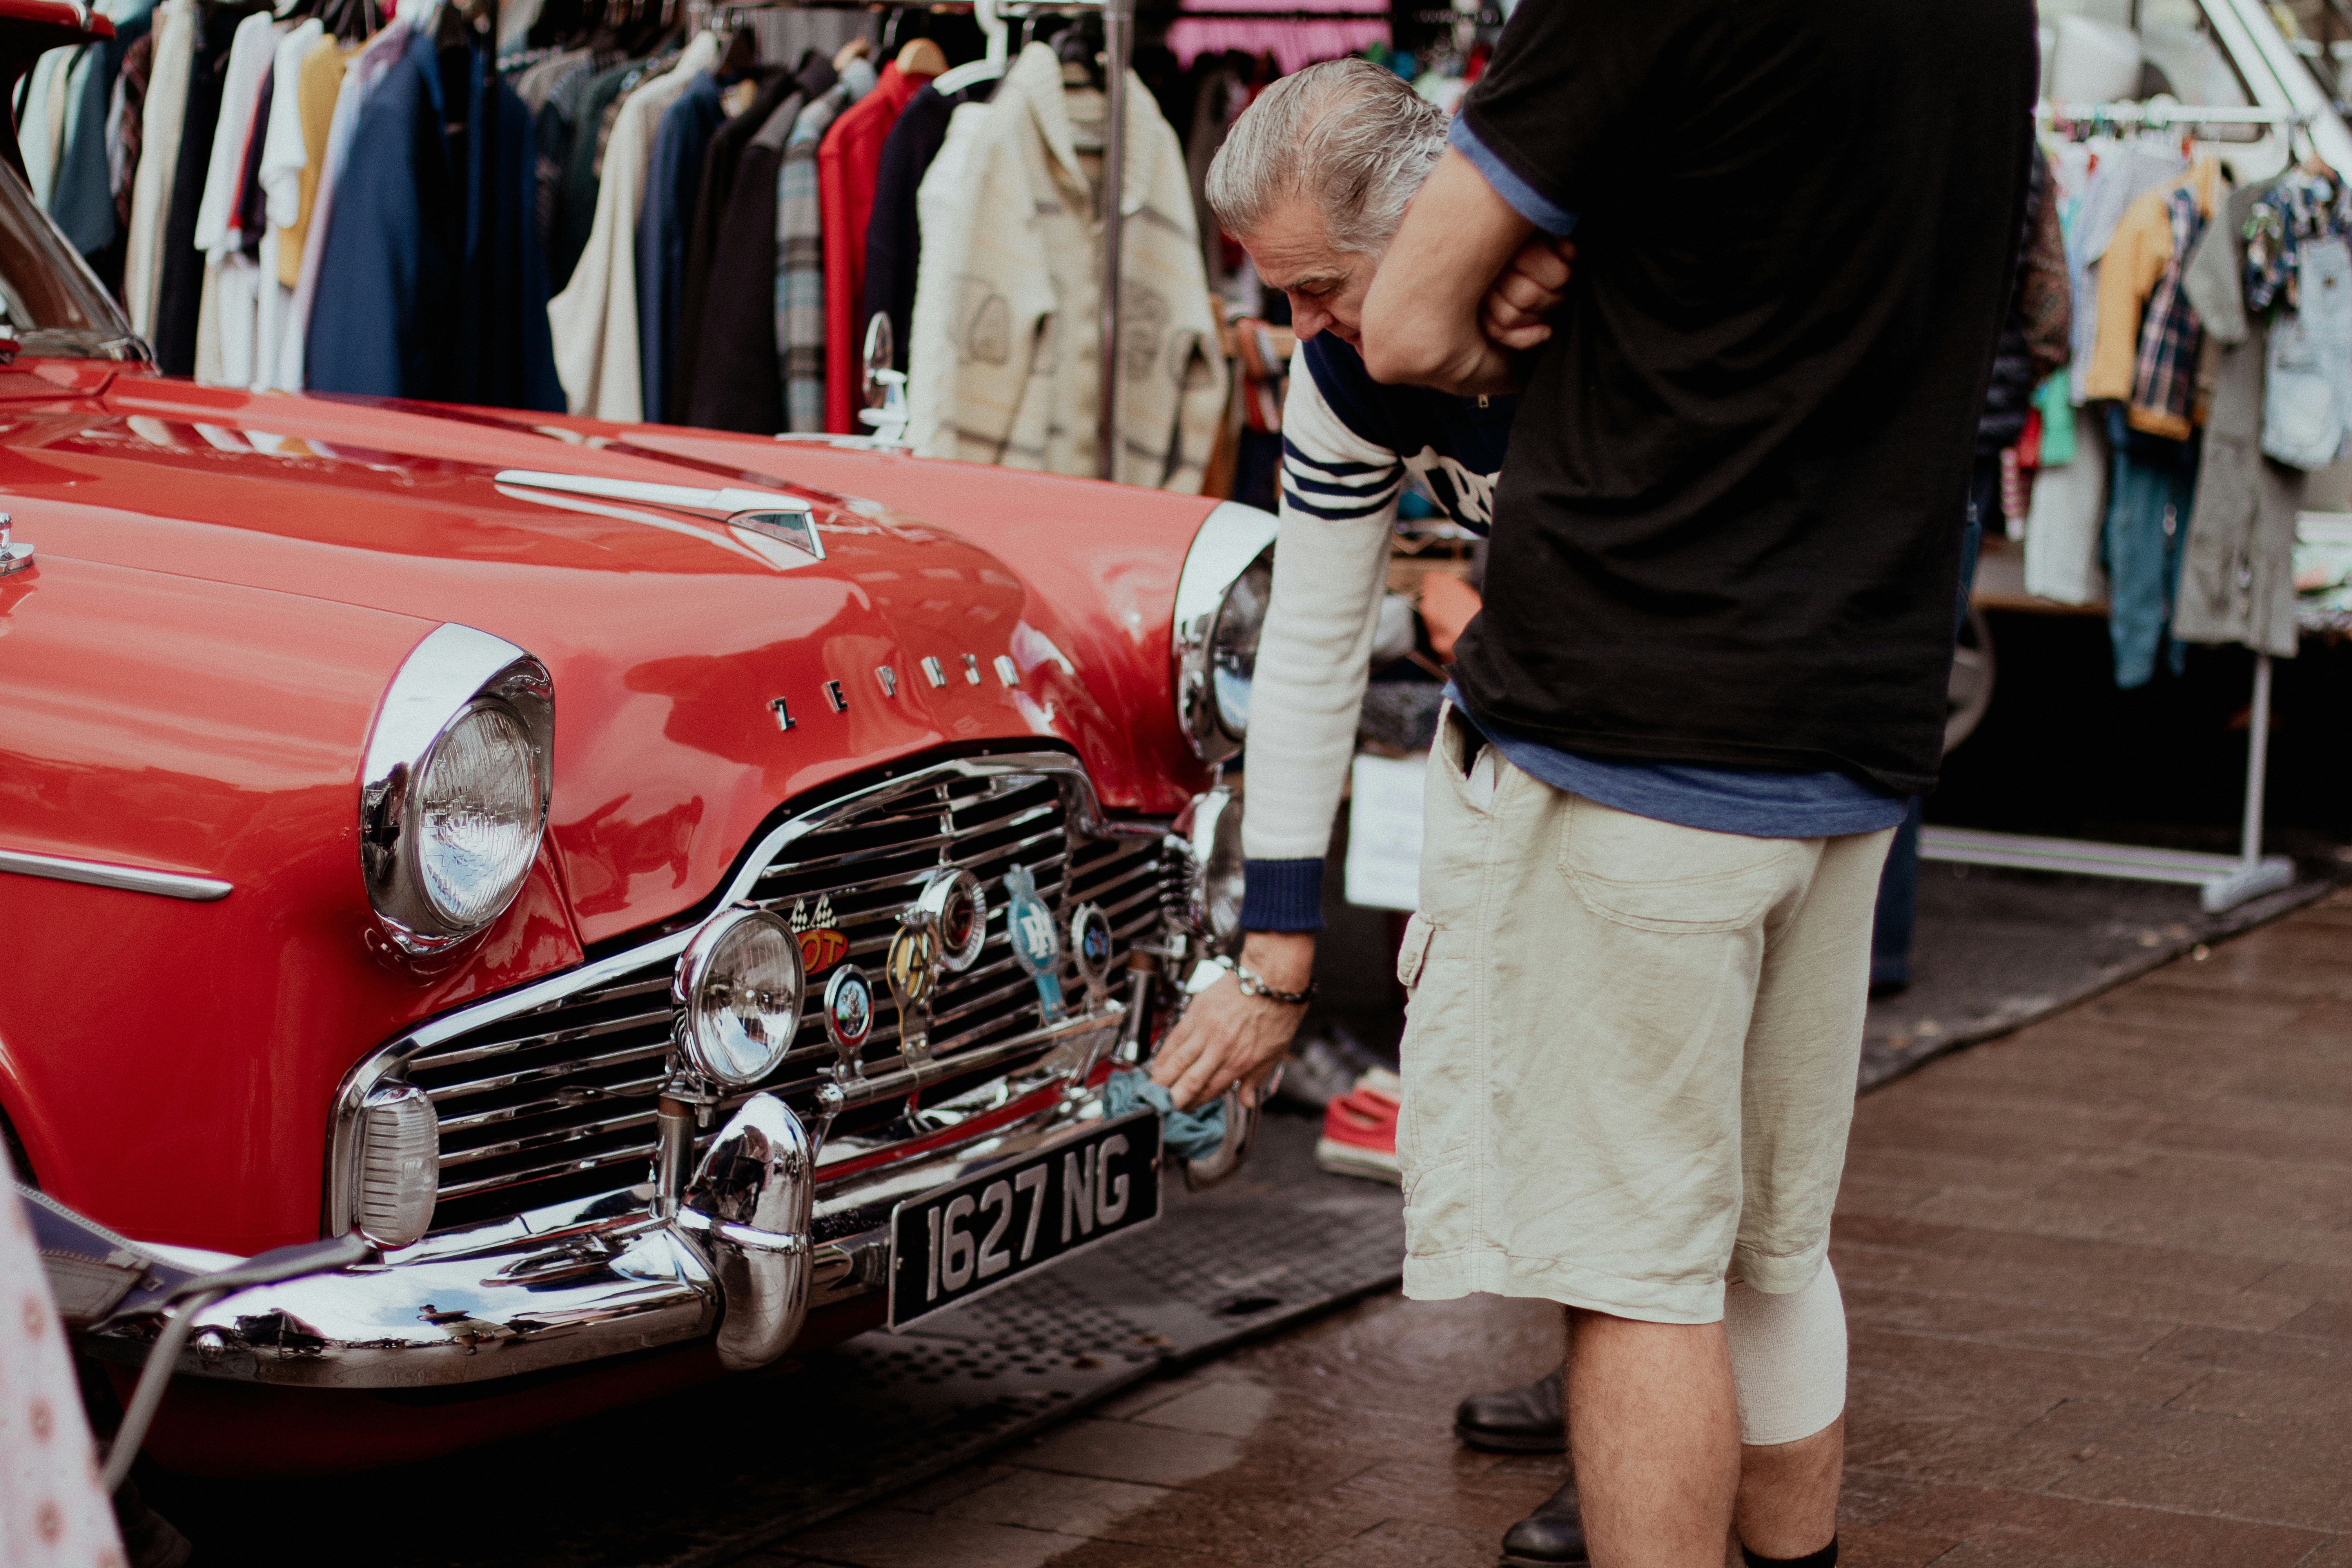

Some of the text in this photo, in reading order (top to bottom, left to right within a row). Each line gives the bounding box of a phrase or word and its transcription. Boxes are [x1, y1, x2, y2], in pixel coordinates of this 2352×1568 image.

[800, 931, 844, 973] OT
[927, 1134, 1129, 1301] 1627 NG
